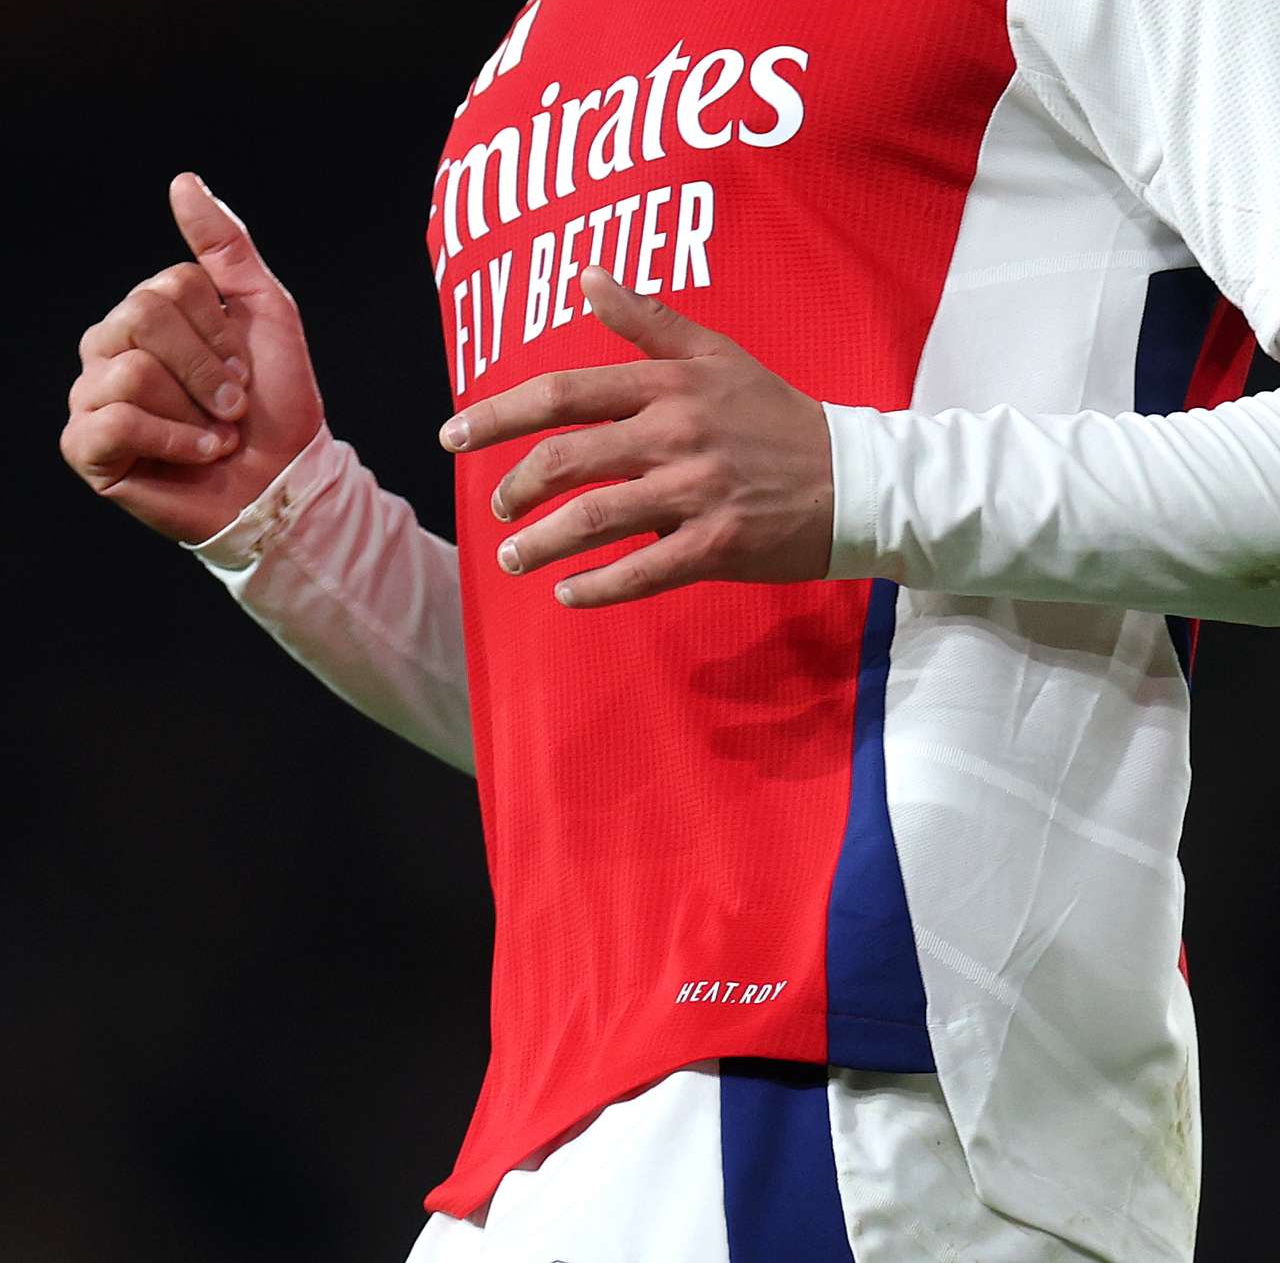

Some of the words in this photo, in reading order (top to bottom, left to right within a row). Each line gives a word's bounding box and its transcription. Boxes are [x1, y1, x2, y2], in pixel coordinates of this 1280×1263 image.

[452, 249, 514, 397] FLY
[523, 180, 715, 344] BETTER
[675, 980, 788, 1004] HEAT.RDY
